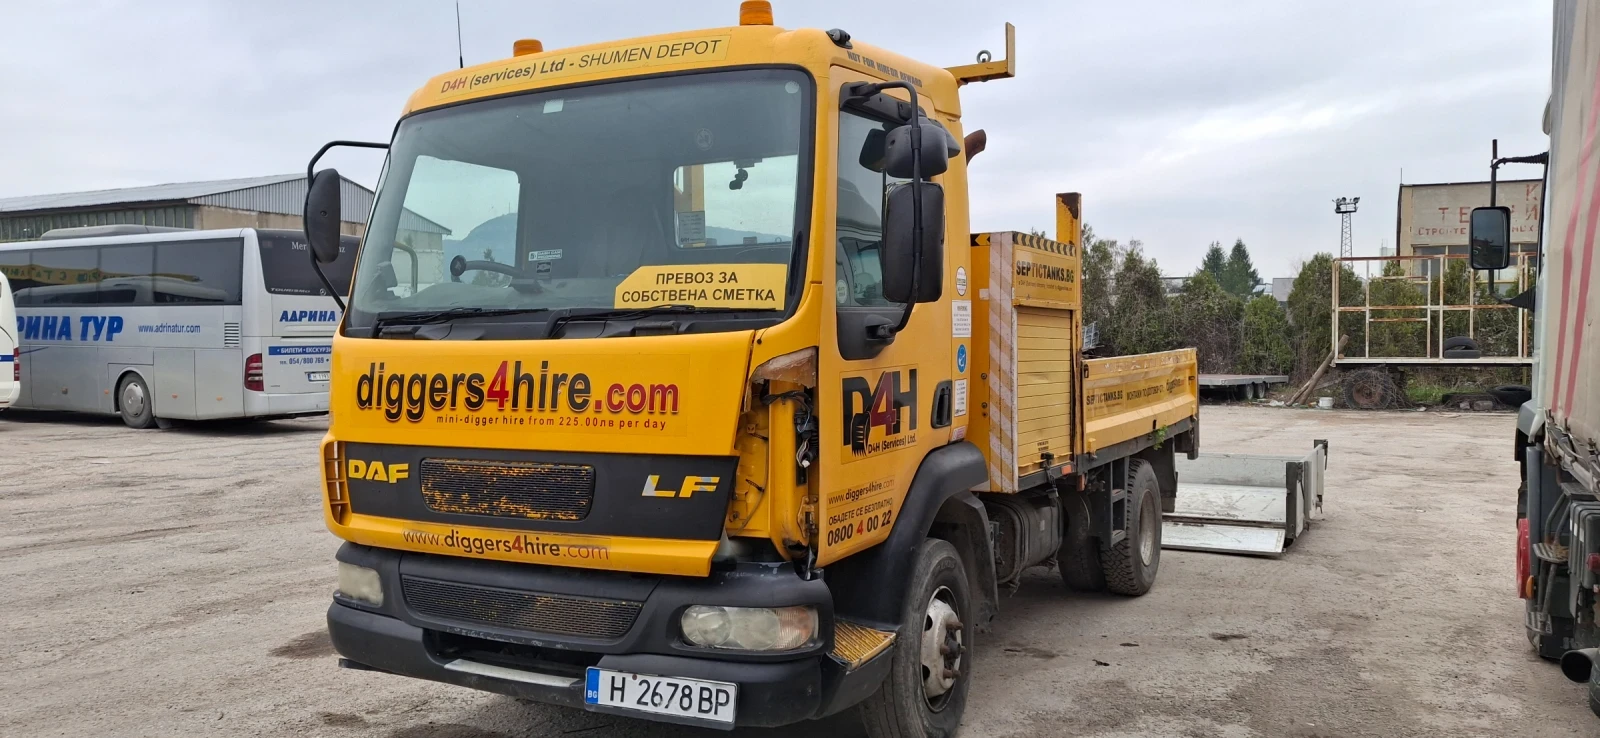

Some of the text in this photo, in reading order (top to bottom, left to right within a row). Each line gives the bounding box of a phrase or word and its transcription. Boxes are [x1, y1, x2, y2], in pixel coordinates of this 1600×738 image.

[441, 77, 467, 93] D4H
[469, 63, 536, 89] (services)
[540, 59, 565, 74] Ltd
[578, 47, 652, 68] SHUMEN
[656, 40, 721, 58] DEPOT
[847, 51, 861, 63] NOT
[862, 56, 876, 68] FOR
[900, 71, 922, 87] REWARD
[656, 271, 738, 284] ПРЕВОЗ ЗА
[1016, 260, 1074, 283] SEPTICTANKS.BG
[622, 288, 775, 302] СОБСТВЕНА СМЕТКА
[80, 316, 123, 341] ТУР
[138, 322, 200, 334] www.adrinatur.com
[279, 311, 335, 322] АДРИНА
[356, 360, 679, 422] diggers4hire.com
[842, 368, 917, 447] D4H
[436, 414, 499, 426] mini-digger
[503, 415, 524, 425] hire
[528, 415, 555, 425] from
[619, 419, 639, 430] per
[644, 419, 666, 431] day
[868, 433, 916, 454] D4H (Services) Ltd.
[348, 459, 409, 483] DAF
[641, 474, 720, 498] LF
[829, 479, 894, 505] www.diggers4hire.com
[829, 498, 893, 526] ОБАДЕТЕ СЕ БЕЗПЛАТНО
[828, 510, 892, 546] 0800 4 00 22
[403, 530, 609, 560] www.diggers4hire.com
[587, 690, 598, 699] BG
[610, 676, 625, 702] H
[637, 680, 693, 711] 2678
